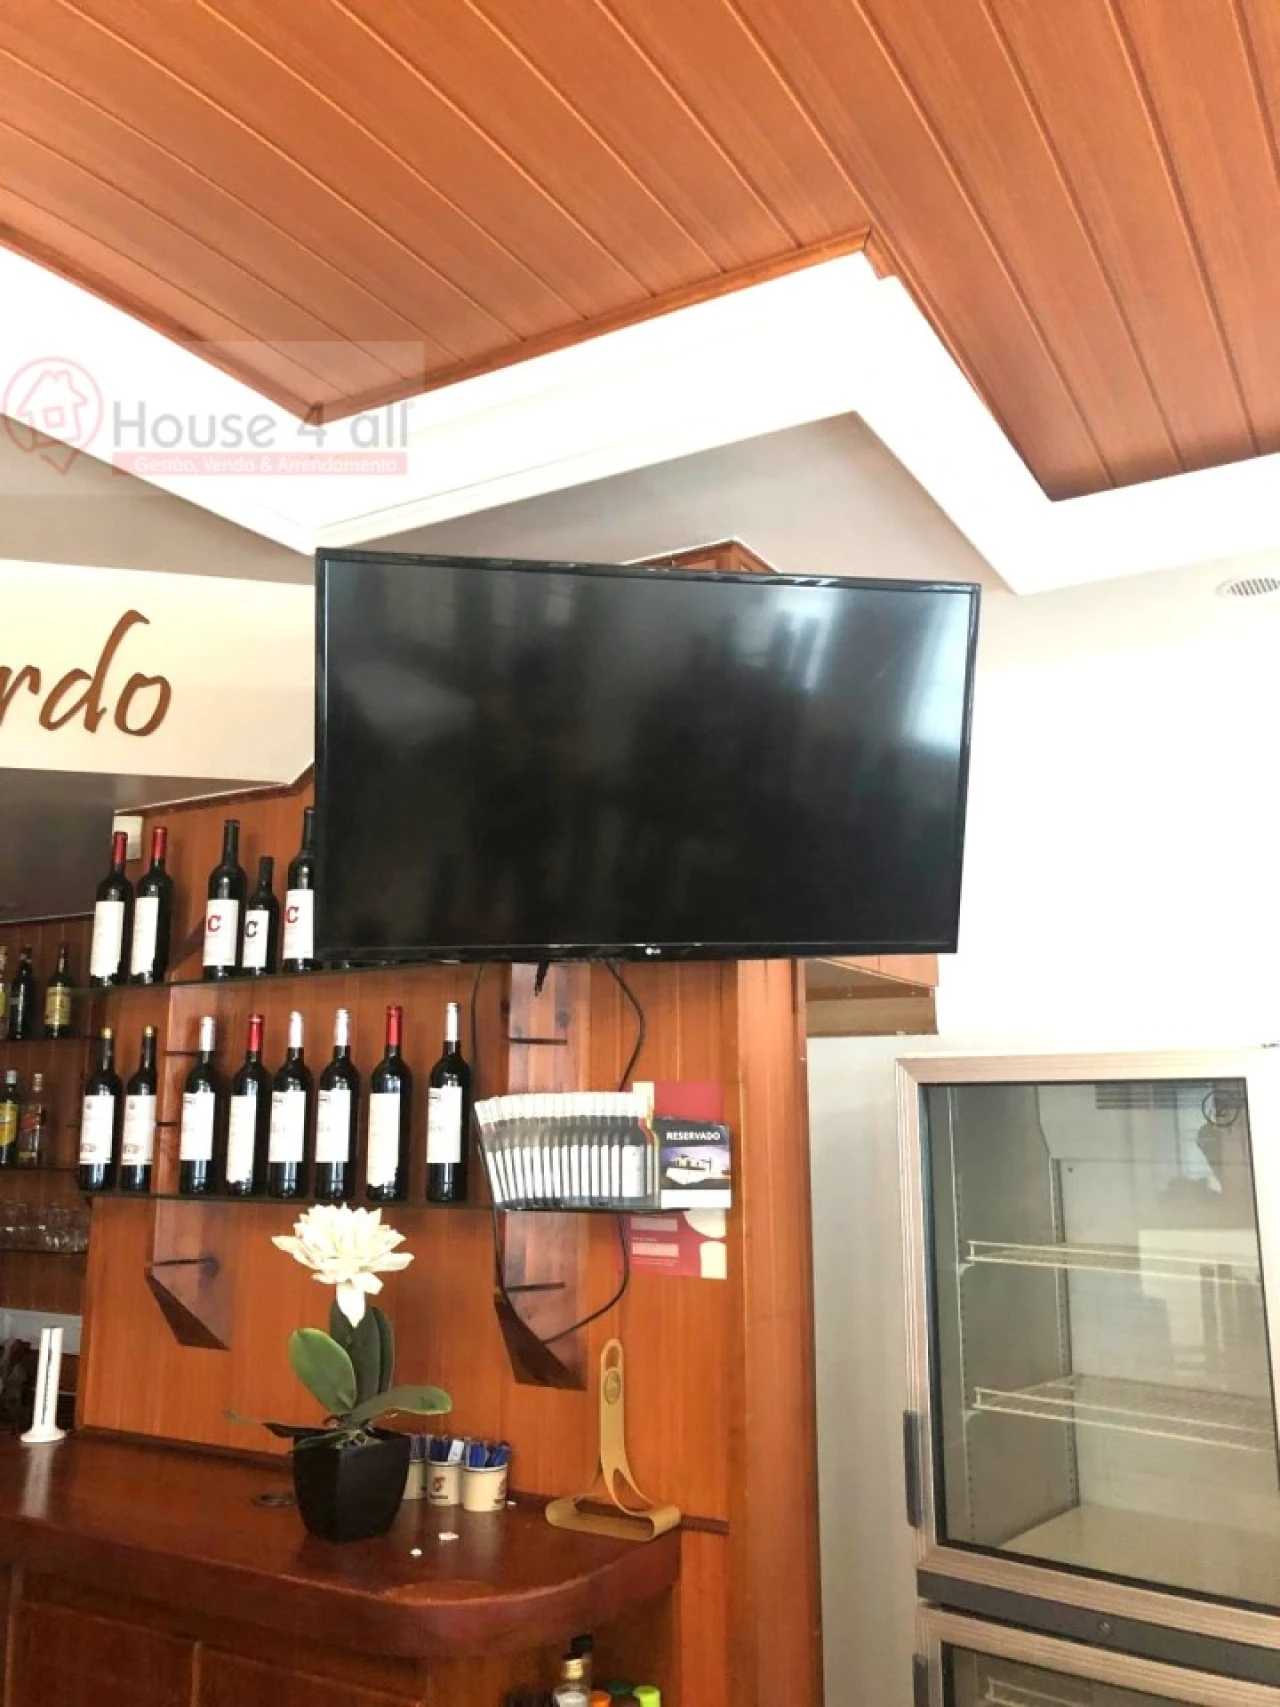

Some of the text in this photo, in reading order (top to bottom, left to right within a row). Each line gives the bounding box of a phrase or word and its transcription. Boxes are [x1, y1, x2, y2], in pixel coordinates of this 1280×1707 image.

[285, 906, 299, 923] C
[208, 915, 221, 932] C
[245, 921, 258, 937] C
[666, 1131, 720, 1141] RESERVADO
